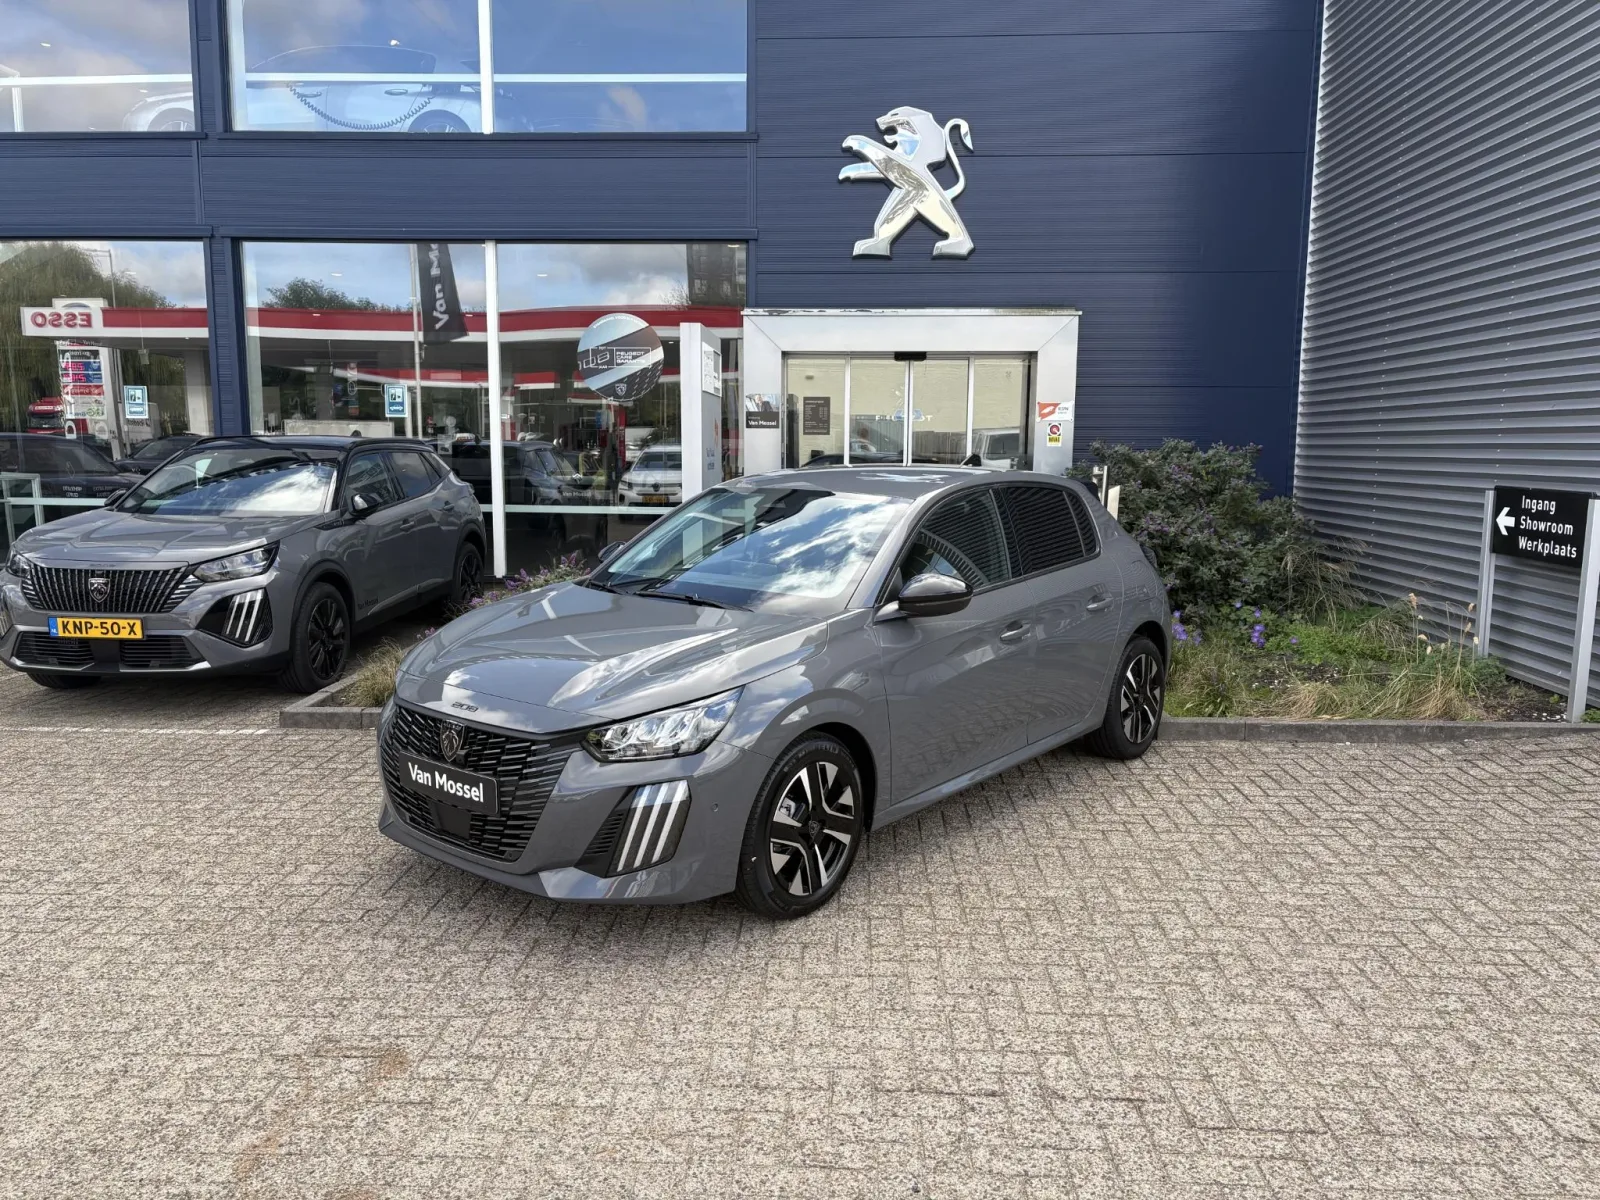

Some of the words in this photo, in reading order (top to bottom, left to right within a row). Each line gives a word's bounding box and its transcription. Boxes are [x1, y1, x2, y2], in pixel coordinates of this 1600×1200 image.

[433, 283, 450, 330] Van
[1522, 495, 1556, 515] Ingang
[1519, 515, 1574, 536] Showroom
[1518, 535, 1577, 558] Werkplaats
[61, 620, 138, 636] KNP-50-X
[450, 701, 479, 713] 208
[408, 762, 432, 787] Van
[434, 771, 484, 803] Mossel
